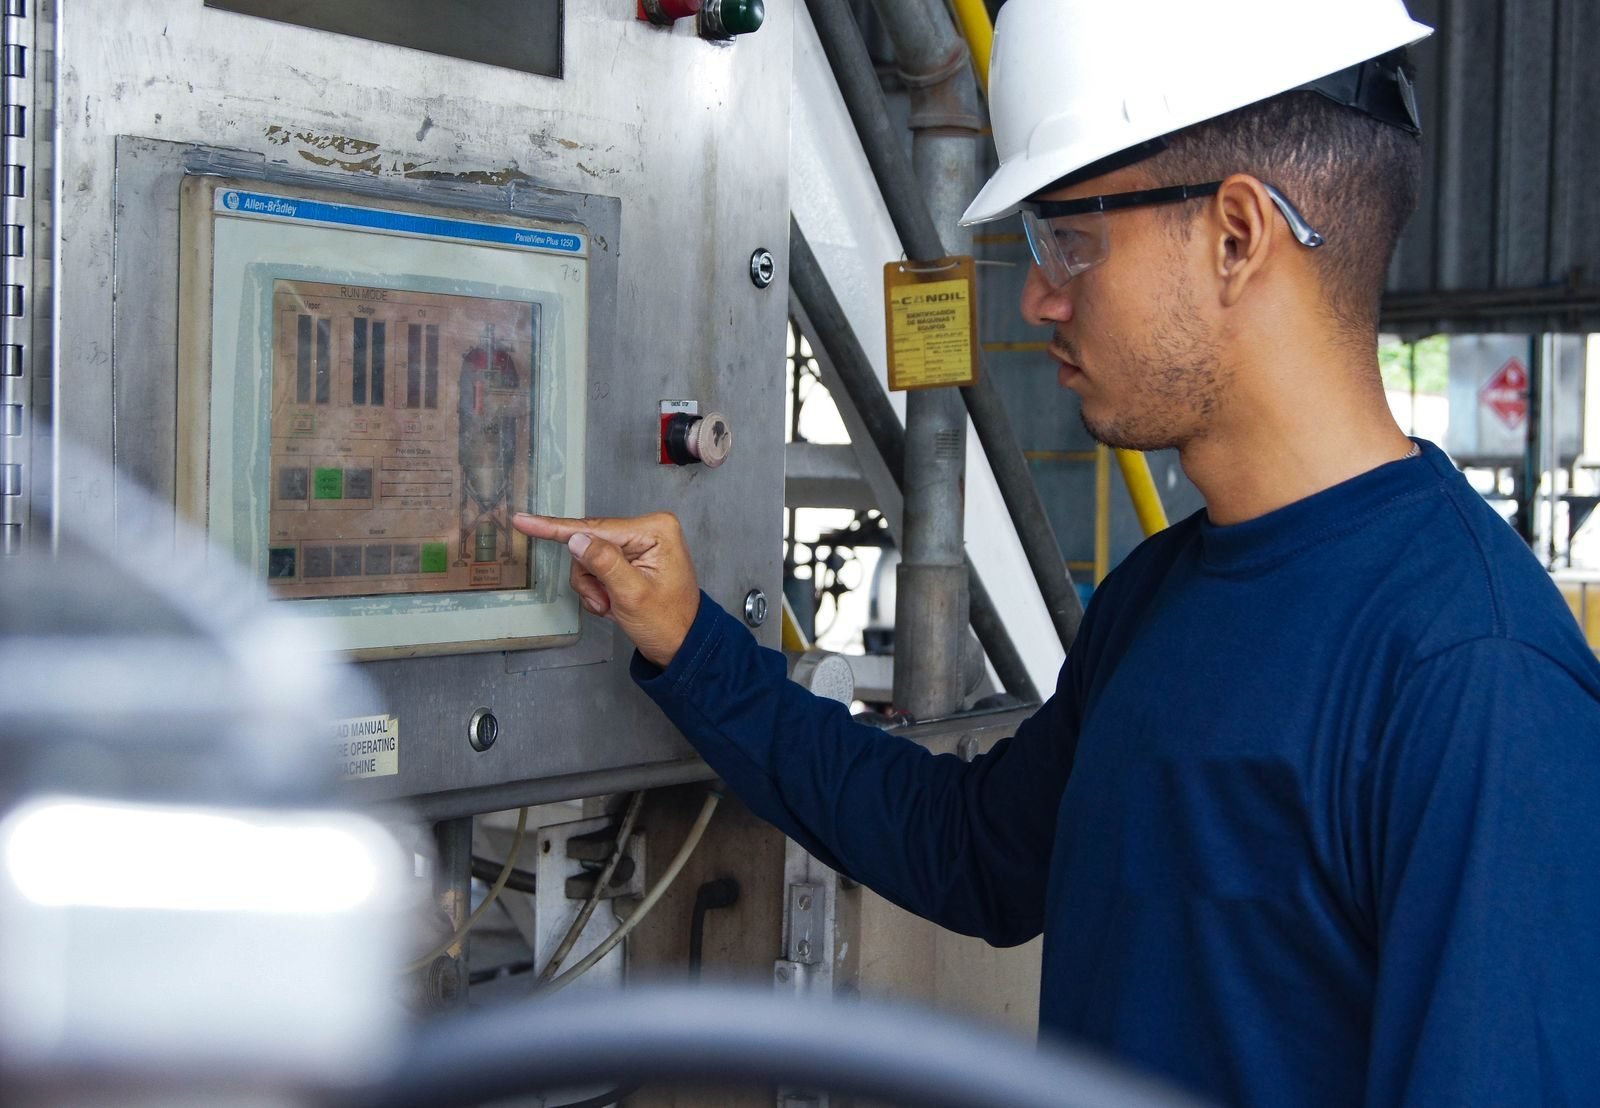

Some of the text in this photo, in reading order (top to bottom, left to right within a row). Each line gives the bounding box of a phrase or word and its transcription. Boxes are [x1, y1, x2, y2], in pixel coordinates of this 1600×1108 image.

[244, 198, 297, 216] Allen-Bradley
[515, 233, 574, 248] PanelView Plus 1250
[340, 286, 388, 301] RUN MODE
[351, 719, 388, 737] MANUAL
[351, 737, 396, 756] OPERATING
[338, 759, 376, 777] ACHINE
